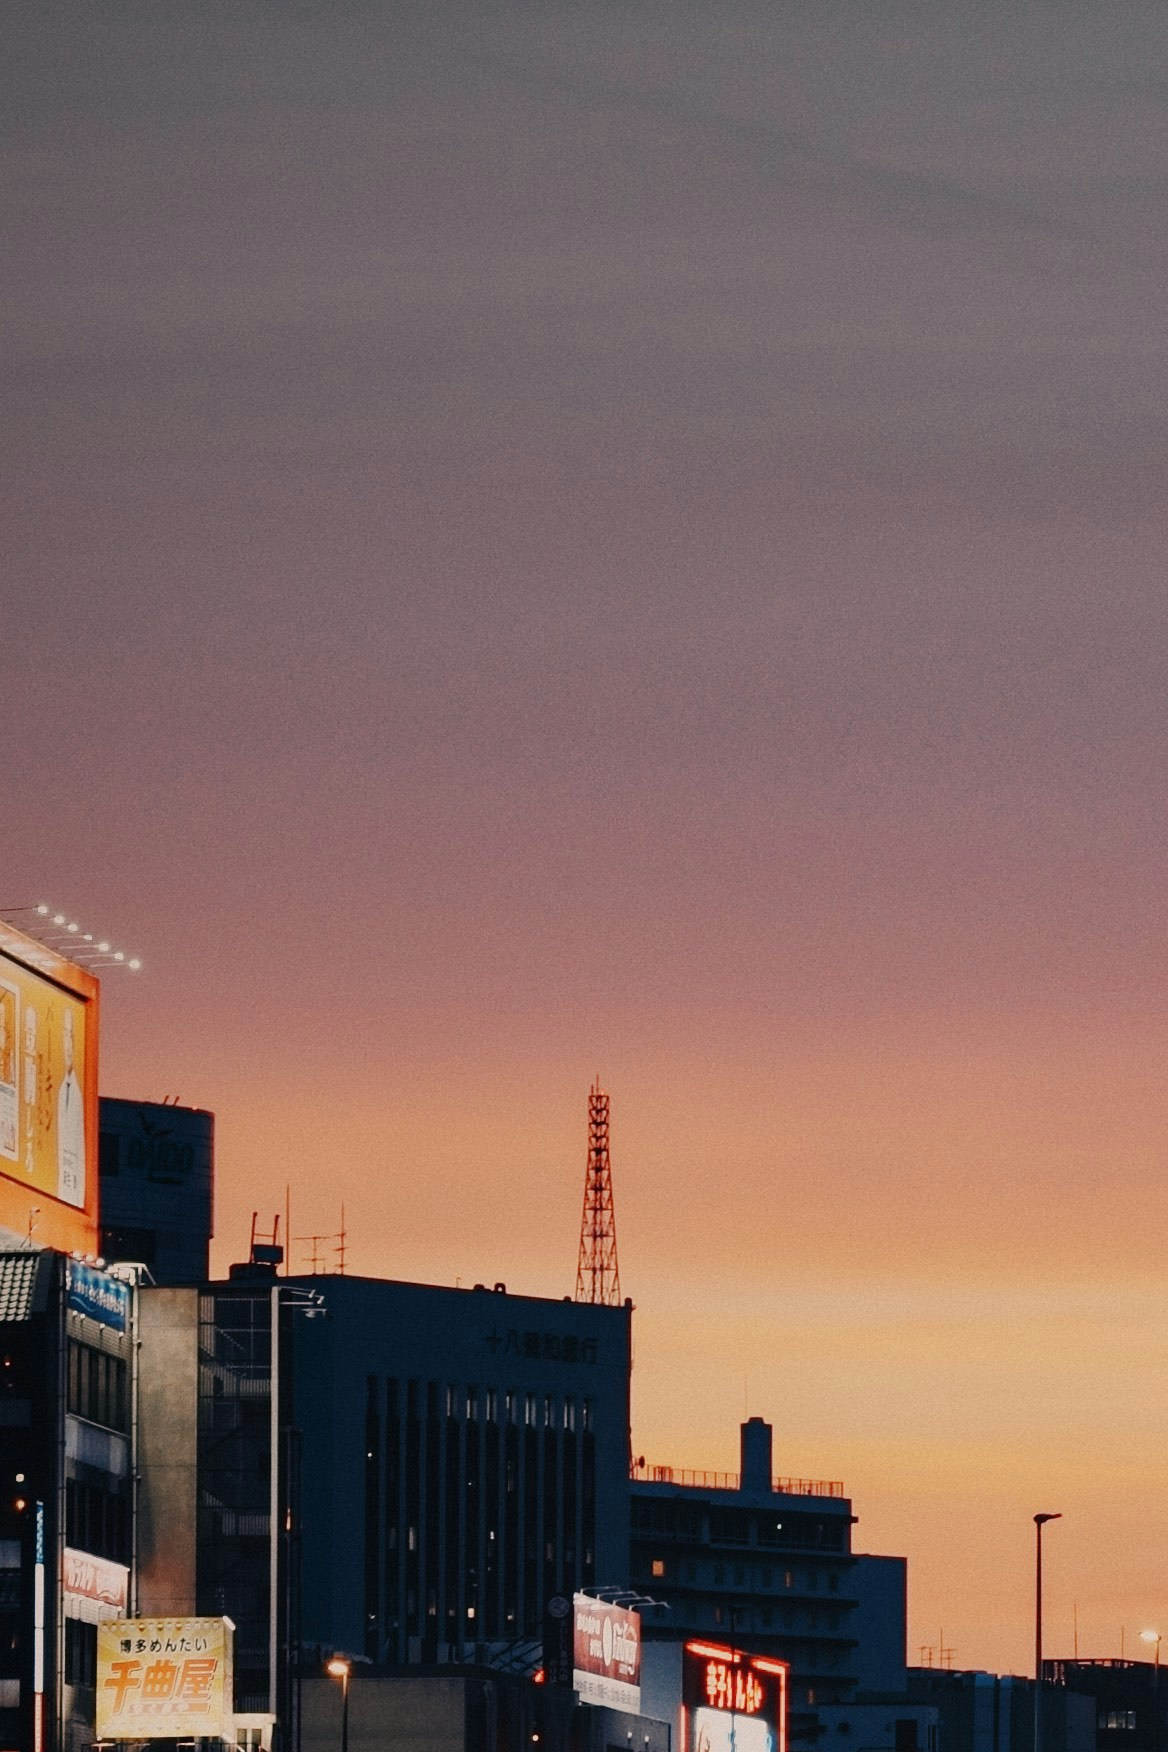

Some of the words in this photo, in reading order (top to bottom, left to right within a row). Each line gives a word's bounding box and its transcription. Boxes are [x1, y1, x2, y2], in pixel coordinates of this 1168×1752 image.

[120, 1637, 208, 1654] 博多めんたい
[104, 1658, 218, 1714] 千曲屋
